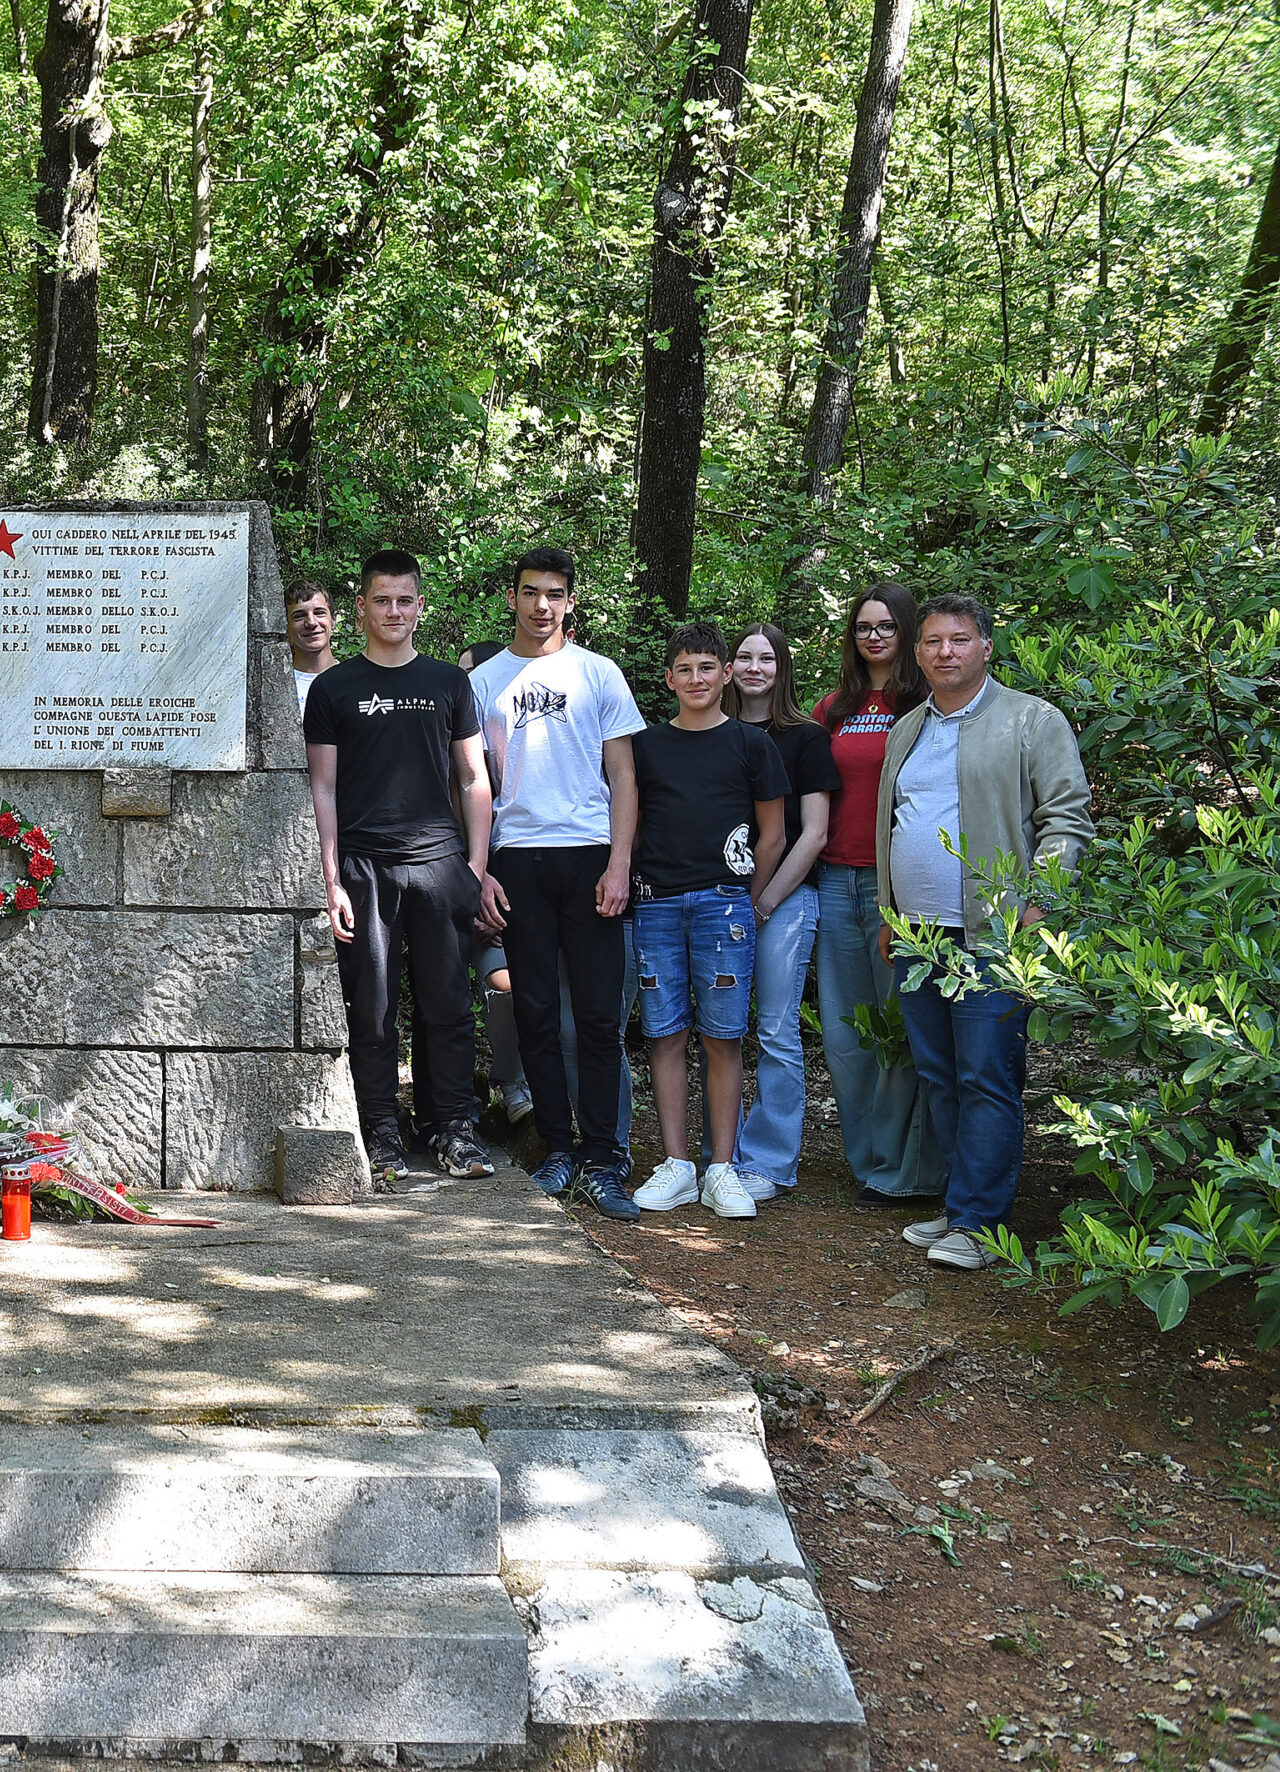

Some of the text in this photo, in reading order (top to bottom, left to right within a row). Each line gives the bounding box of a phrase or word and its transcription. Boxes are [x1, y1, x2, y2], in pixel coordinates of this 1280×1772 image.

[32, 530, 51, 539] QUI
[56, 530, 106, 539] CADDERO
[143, 530, 180, 539] APRILE
[185, 531, 206, 539] DEL
[32, 547, 215, 556] VITTIME DEL TERRORE FASCISTA
[2, 570, 30, 579] K.P.J.
[47, 570, 168, 579] MEMBRO DEL P.C.J.
[2, 589, 30, 597] K.P.J.
[47, 589, 168, 598] MEMBRO DEL P.C.J.
[2, 606, 41, 615] S.K.O.J.
[47, 606, 179, 616] MEMBRO DELLO S.K.O.J.
[2, 625, 30, 634] K.P.J.
[46, 625, 168, 634] MEMBRO DEL P.C.J.
[2, 643, 29, 652] K.P.J.
[46, 643, 168, 652] MEMBRO DEL P.C.J.
[34, 697, 196, 708] IN MEMORIA DELLE EROICHE
[396, 698, 435, 706] ALPHA
[34, 712, 216, 722] COMPAGNE QUESTA LAPIDE POSE
[843, 714, 894, 724] POSITAN
[47, 726, 89, 735] UNIONE
[97, 727, 114, 735] DEI
[122, 727, 201, 736] COMBATTENTI
[34, 740, 53, 750] DEL
[71, 741, 104, 750] RIONE
[112, 741, 123, 750] DI
[131, 741, 164, 751] FIUME
